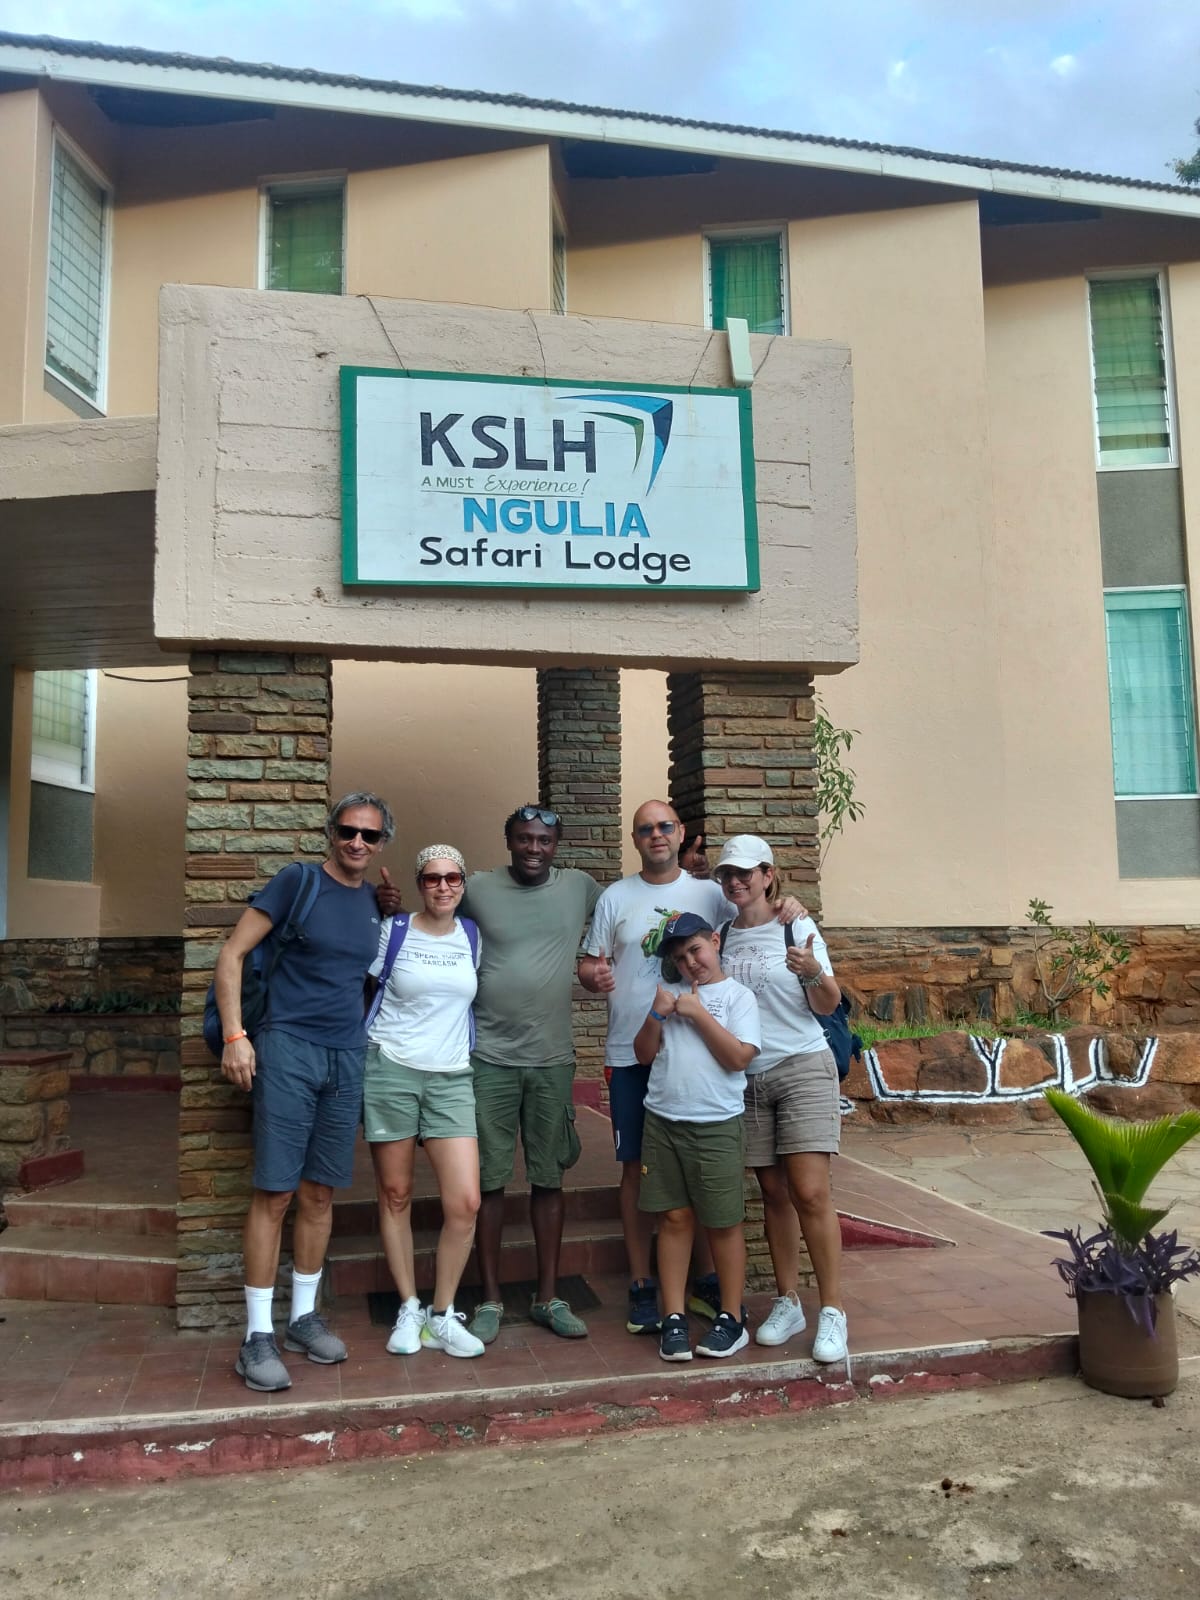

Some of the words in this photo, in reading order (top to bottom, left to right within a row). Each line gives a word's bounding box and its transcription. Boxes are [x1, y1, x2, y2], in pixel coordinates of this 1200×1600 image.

[420, 412, 597, 473] KSLH
[421, 476, 432, 487] A
[484, 474, 591, 495] Experience!
[463, 497, 650, 538] NGULIA
[419, 536, 542, 568] Safari
[565, 540, 691, 585] Lodge
